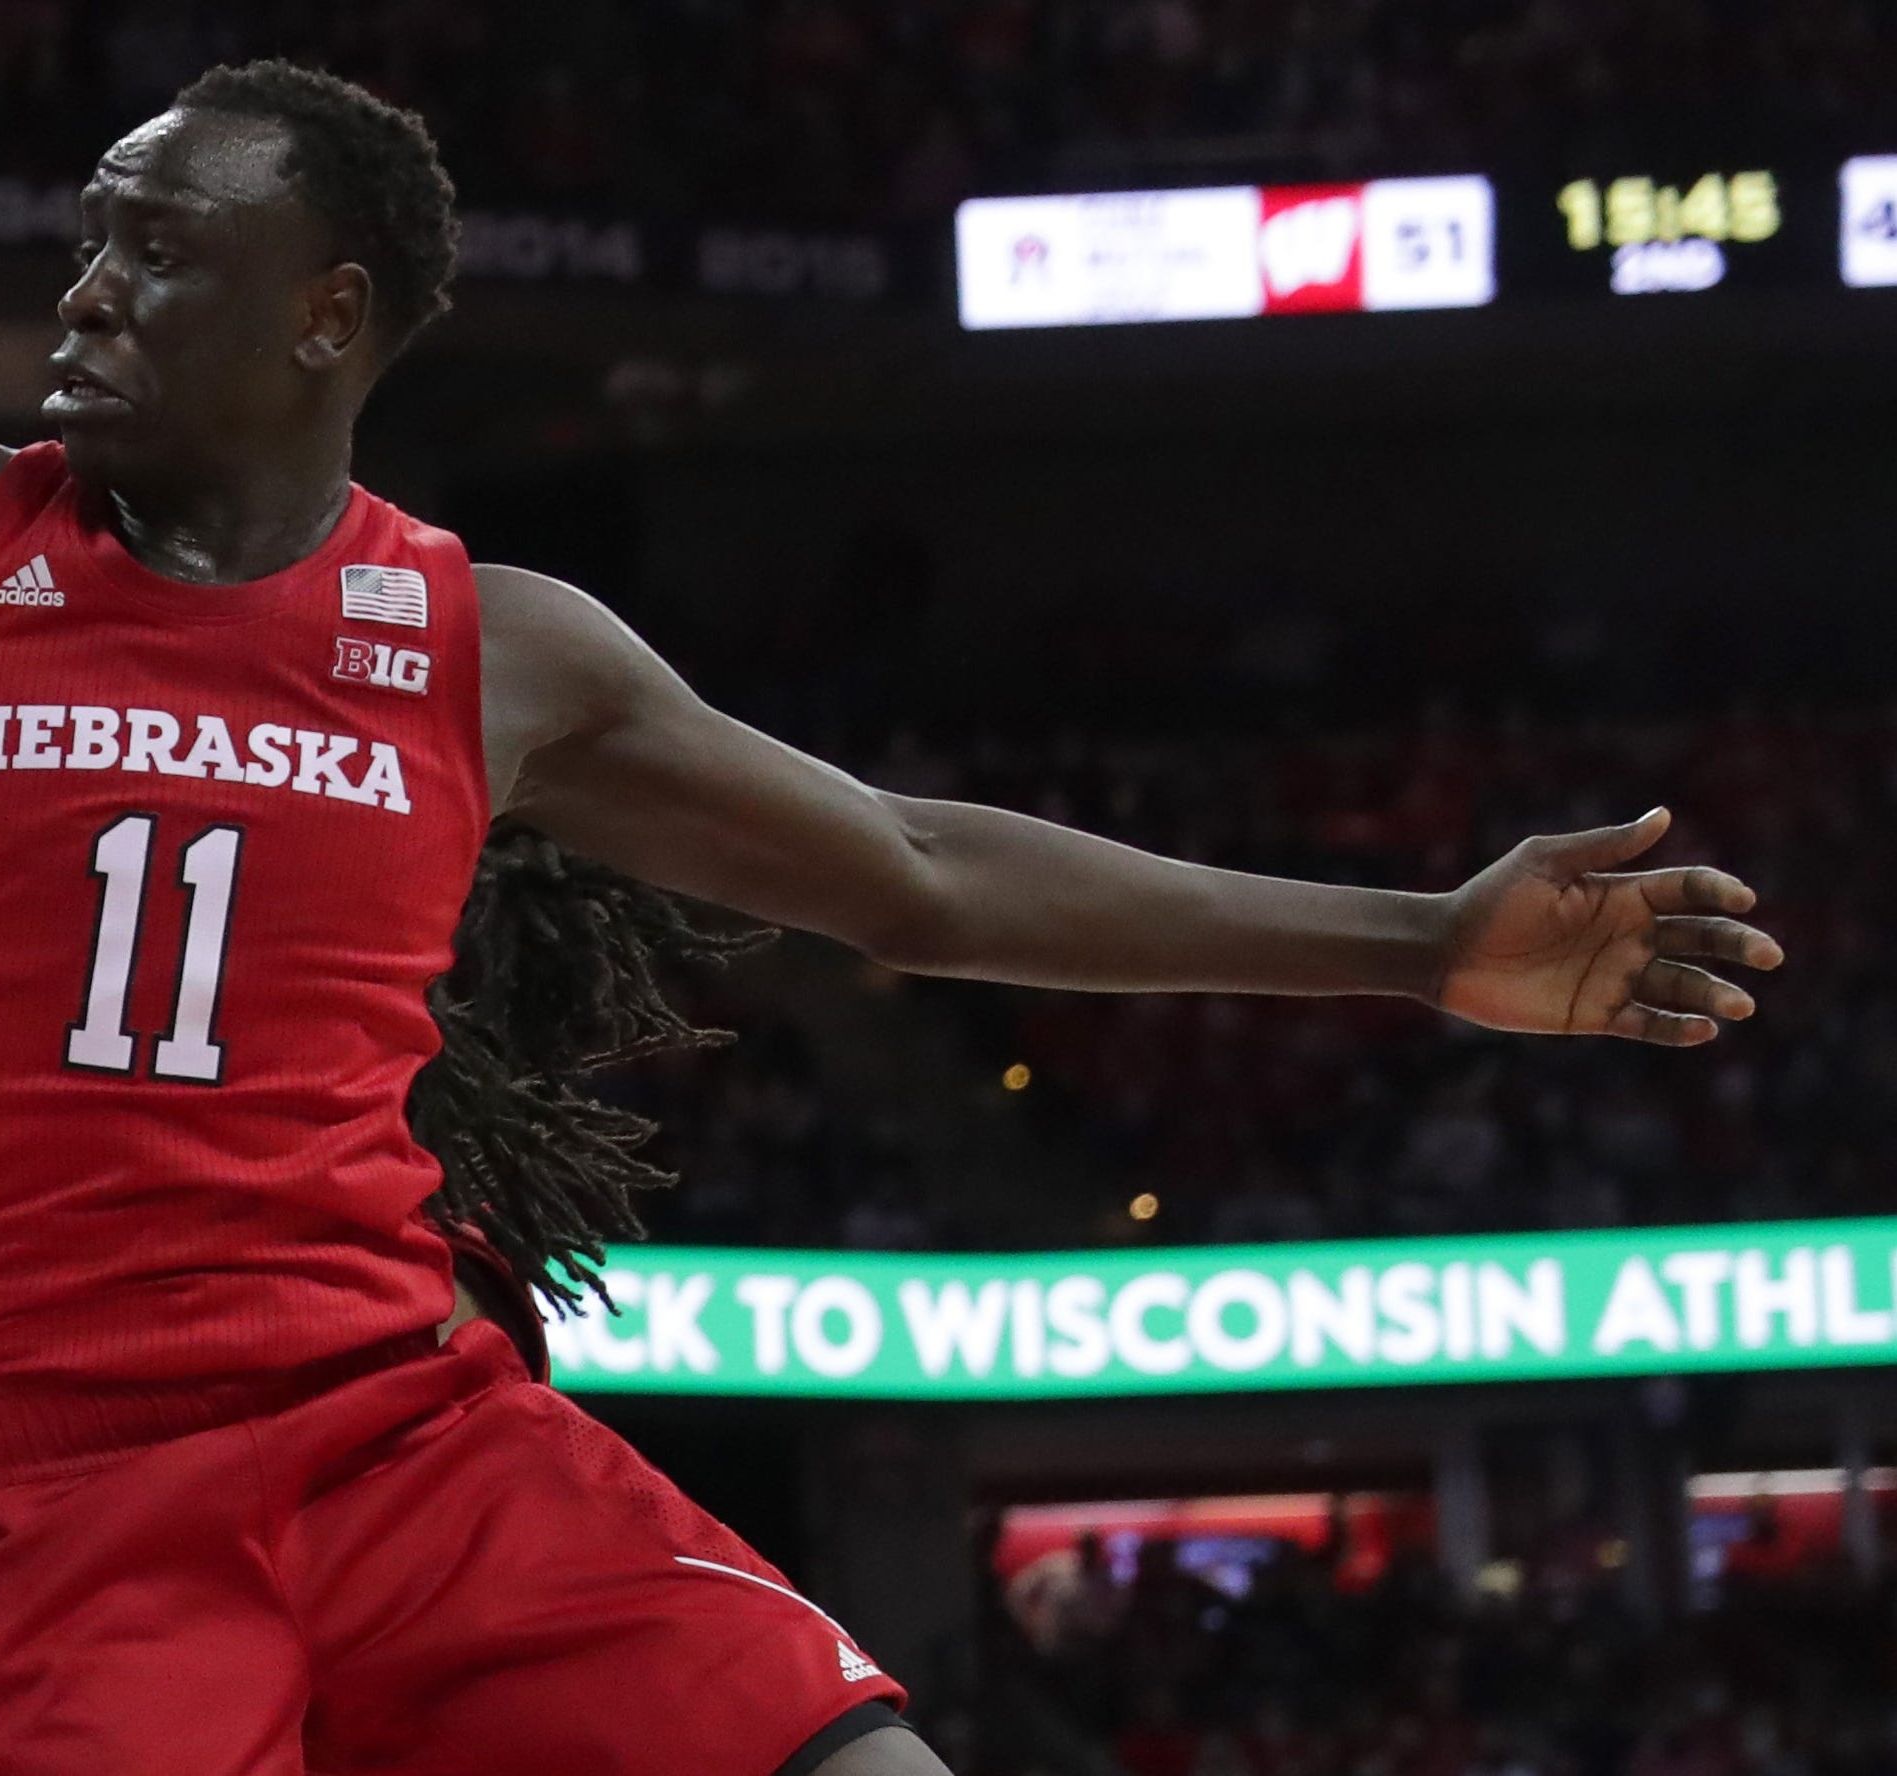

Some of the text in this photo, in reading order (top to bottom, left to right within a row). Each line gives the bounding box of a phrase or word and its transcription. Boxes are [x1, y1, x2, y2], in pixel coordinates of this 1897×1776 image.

[62, 811, 246, 1088] 11
[736, 1273, 883, 1378] TO
[897, 1256, 1567, 1379] WISCONSIN
[1592, 1246, 1897, 1357] ATHL
